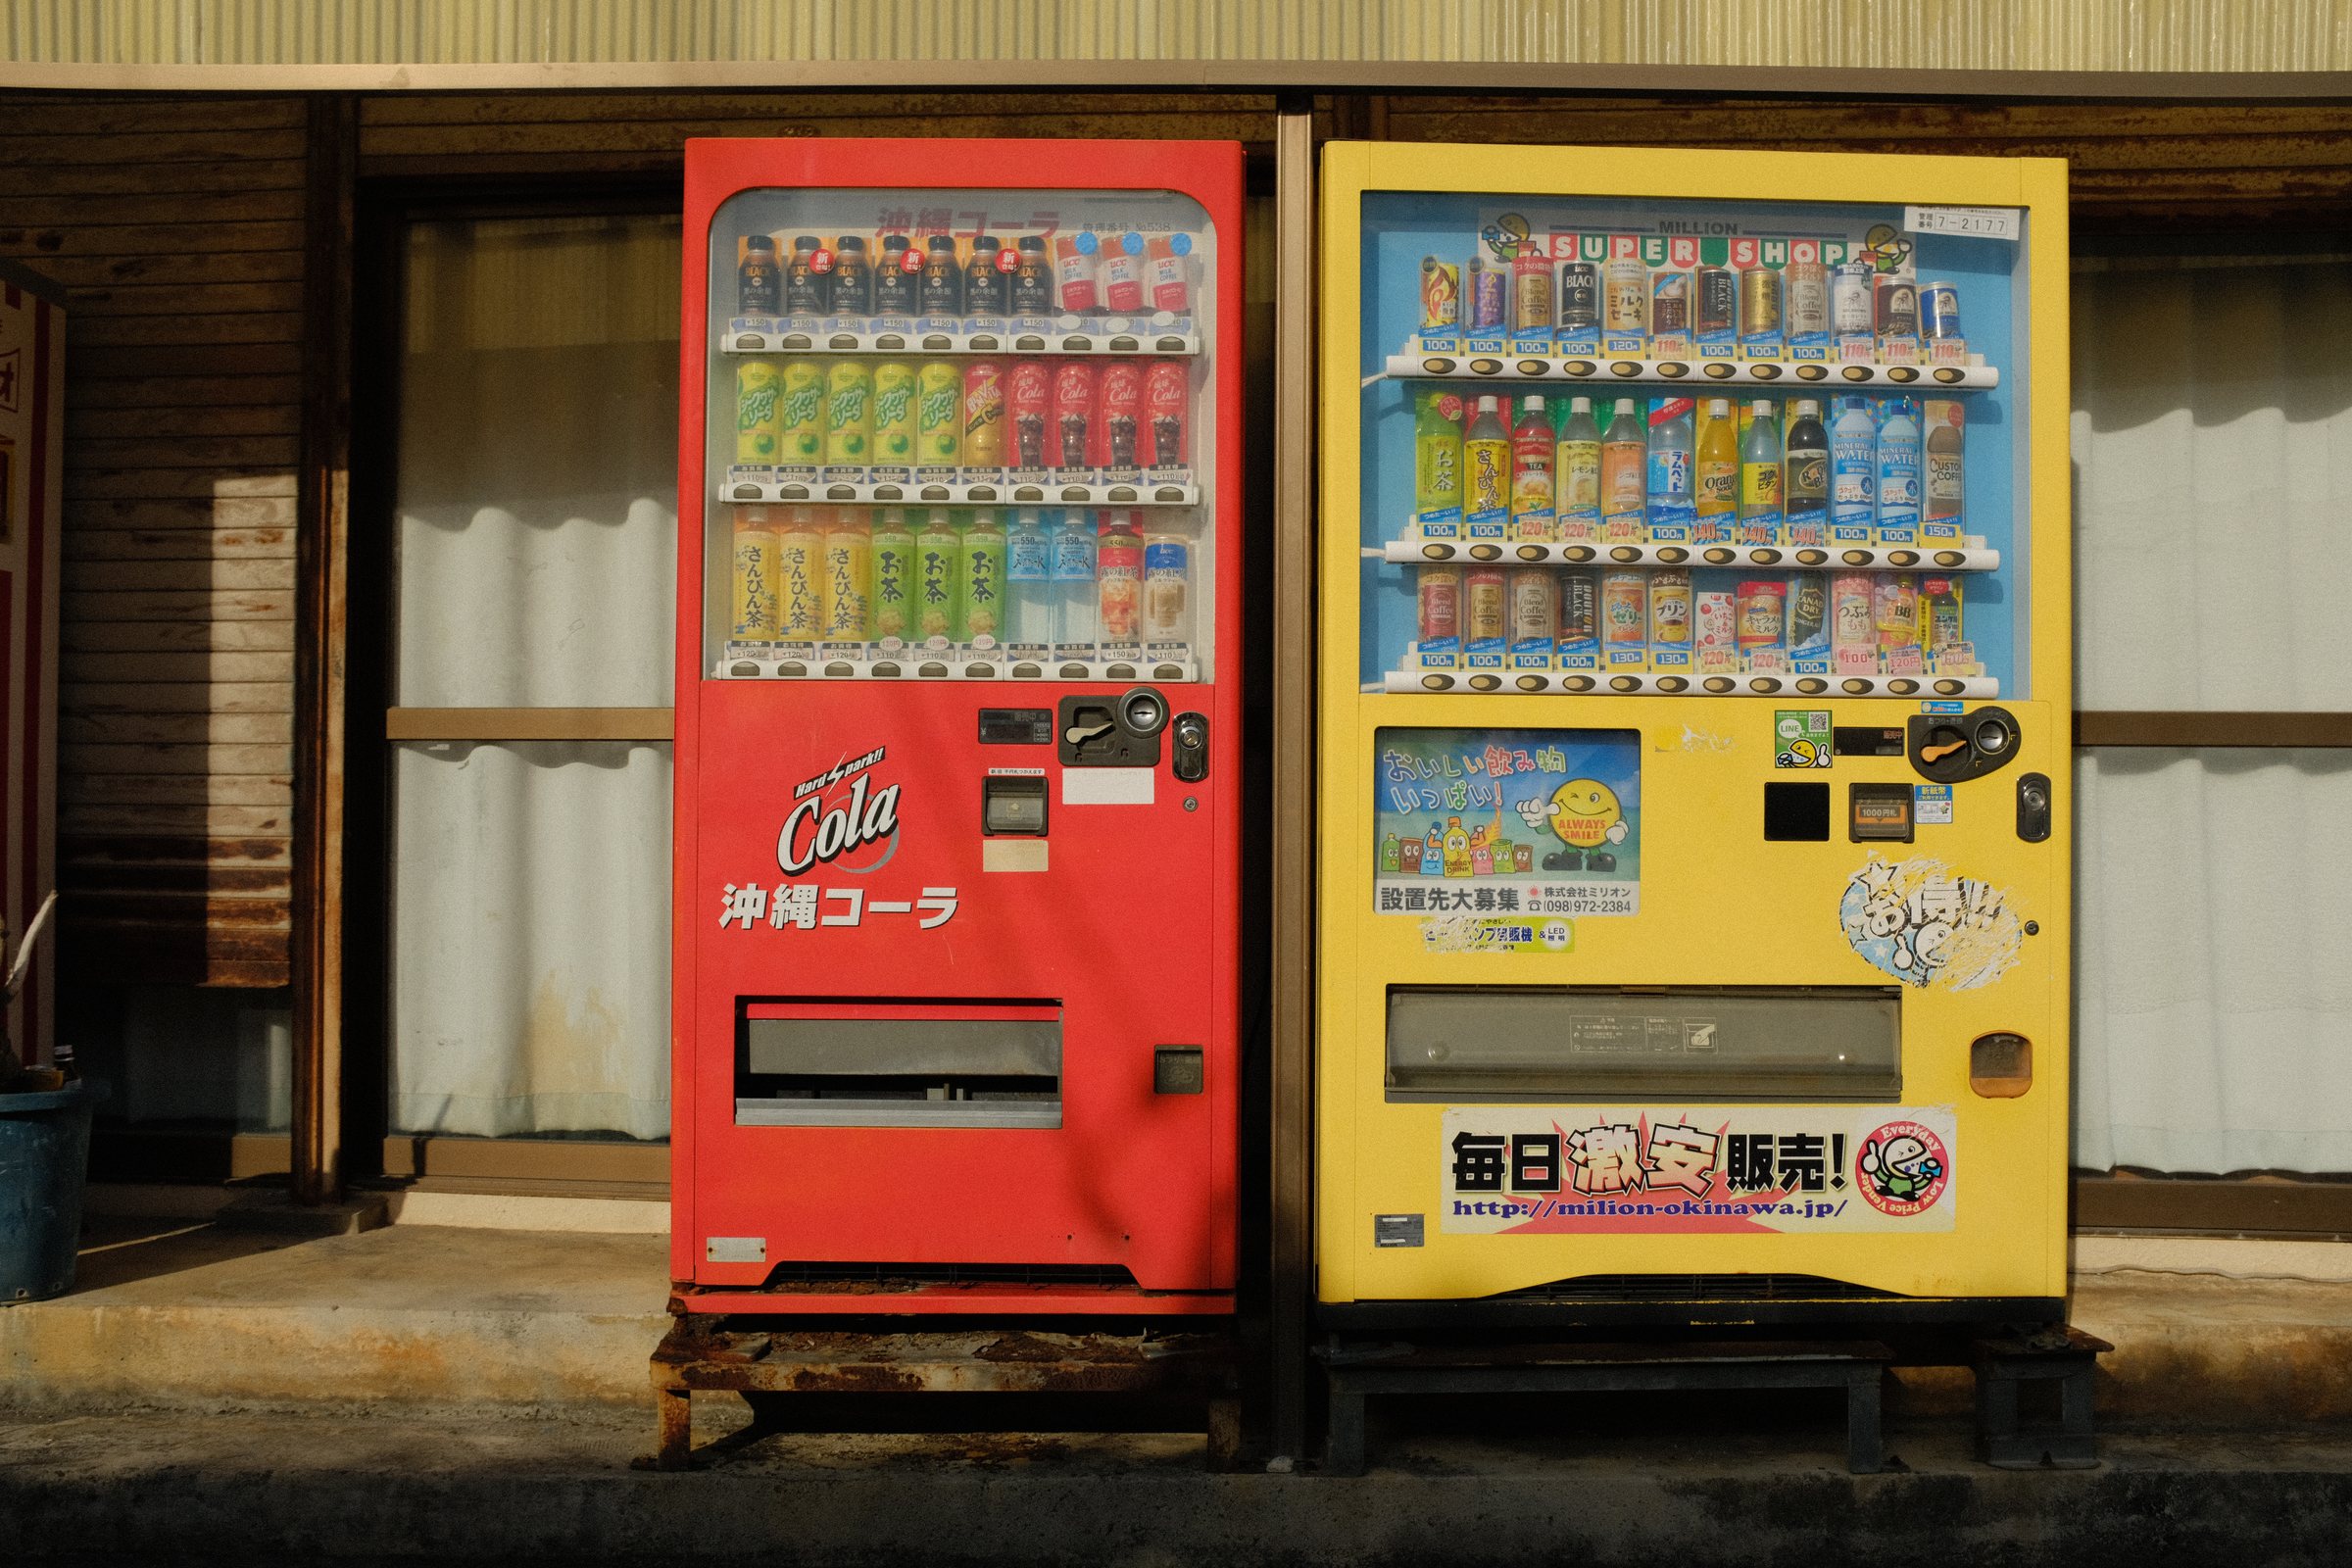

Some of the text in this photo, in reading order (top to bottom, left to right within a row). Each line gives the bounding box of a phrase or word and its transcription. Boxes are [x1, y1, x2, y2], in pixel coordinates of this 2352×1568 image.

[875, 207, 1060, 238] 沖縄コーラ
[1659, 220, 1739, 235] MILLION
[1937, 216, 2006, 233] 7-2177
[1554, 236, 1844, 264] SUPER SHOP
[816, 253, 829, 265] 新
[906, 253, 918, 265] 新
[1004, 253, 1014, 265] 新
[1566, 276, 1593, 288] BLACK
[1718, 278, 1727, 312] BLACK
[1610, 296, 1643, 307] ミルク
[1611, 309, 1642, 321] セーキ
[1426, 341, 1452, 351] 100円
[1473, 341, 1499, 352] 100円
[1520, 343, 1546, 353] 100円
[1565, 343, 1592, 354] 100円
[1611, 341, 1638, 351] 120円
[1703, 346, 1731, 356] 100円
[1750, 347, 1776, 357] 100円
[1796, 348, 1823, 359] 100円
[1017, 385, 1045, 402] Cola
[1060, 386, 1088, 400] Cola
[1109, 388, 1137, 403] Cola
[1152, 388, 1181, 402] Cola
[1435, 450, 1455, 490] お茶
[1478, 449, 1500, 512] さんぴん茶
[1427, 525, 1454, 537] 100円
[1474, 525, 1501, 537] 100円
[1654, 528, 1682, 539] 100円
[1838, 529, 1864, 539] 100円
[1884, 530, 1911, 541] 100円
[1928, 525, 1953, 537] 150円
[880, 551, 904, 604] お茶
[924, 551, 949, 605] お茶
[971, 551, 996, 604] お茶
[746, 547, 762, 628] さんぴん茶
[790, 548, 808, 629] さんぴん茶
[834, 549, 853, 630] さんぴん茶
[1574, 584, 1584, 617] BLACK
[1798, 596, 1824, 608] CANAD
[1428, 606, 1452, 614] Coffee
[1474, 606, 1497, 614] Coffee
[1521, 606, 1545, 614] Coffee
[1656, 604, 1688, 617] プリン
[1803, 604, 1821, 615] DRY
[1894, 606, 1911, 617] BB
[1755, 625, 1778, 634] ミルク
[1847, 619, 1867, 631] もも
[1425, 656, 1452, 666] 100円
[1472, 656, 1499, 666] 100円
[1519, 657, 1545, 666] 100円
[1566, 657, 1592, 667] 100円
[1613, 653, 1641, 662] 130円
[1660, 655, 1686, 664] 130円
[1889, 657, 1921, 668] 120円
[1797, 662, 1825, 673] 100円
[1384, 745, 1566, 782] おいしい飲み物
[795, 773, 827, 798] Hard
[1922, 786, 1946, 796] 新紙幣
[1390, 780, 1502, 815] いっぱい!
[1862, 808, 1897, 817] 1000円札
[776, 772, 900, 877] Cola
[1558, 818, 1606, 830] ALWAYS
[1563, 830, 1600, 840] SMILE
[1544, 886, 1631, 898] 株式会社ミリオン
[1381, 887, 1519, 911] 設置先大募集
[718, 883, 958, 929] 沖縄コーラ
[1543, 900, 1631, 913] (098)972-2384
[1881, 1124, 1941, 1151] Everyday
[1450, 1123, 1848, 1200] 毎日激安販売!
[1922, 1180, 1944, 1205] Low
[1452, 1199, 1848, 1219] http://milion-okinawa.jp/
[1889, 1201, 1921, 1215] Price
